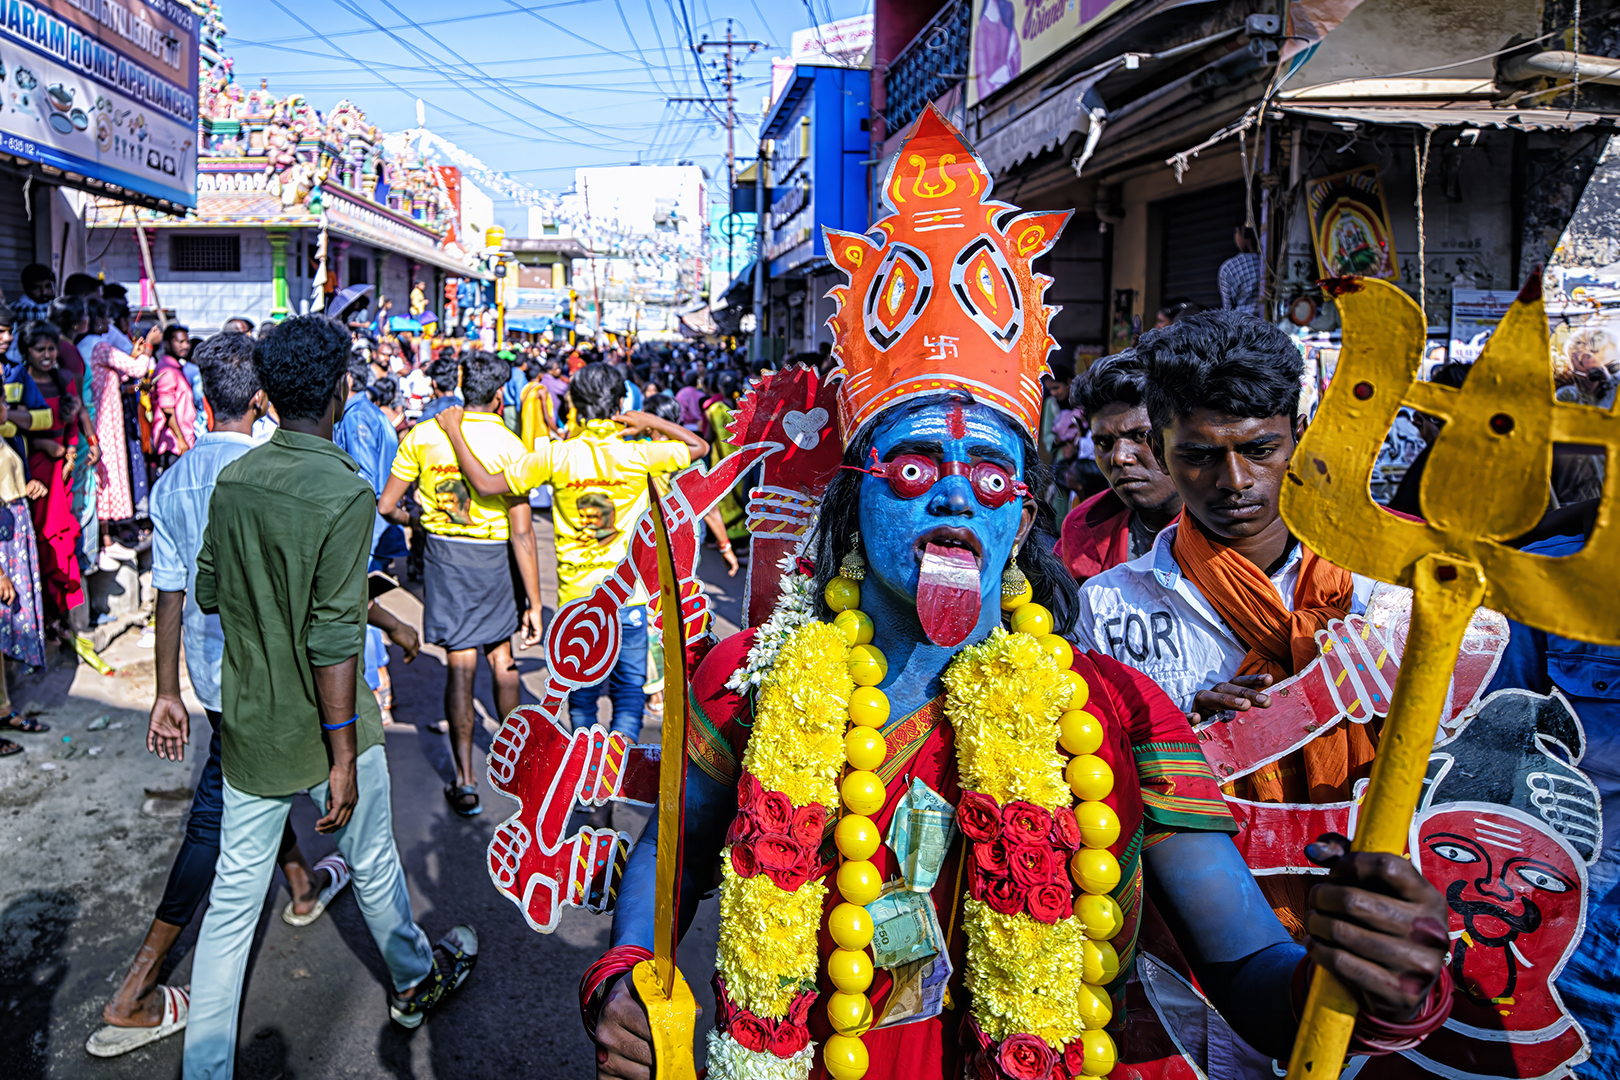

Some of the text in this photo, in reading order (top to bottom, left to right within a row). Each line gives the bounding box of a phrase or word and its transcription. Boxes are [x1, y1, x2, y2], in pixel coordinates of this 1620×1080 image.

[68, 26, 117, 86] HOME
[117, 55, 194, 125] APPLIANCES
[1103, 611, 1180, 662] FOR
